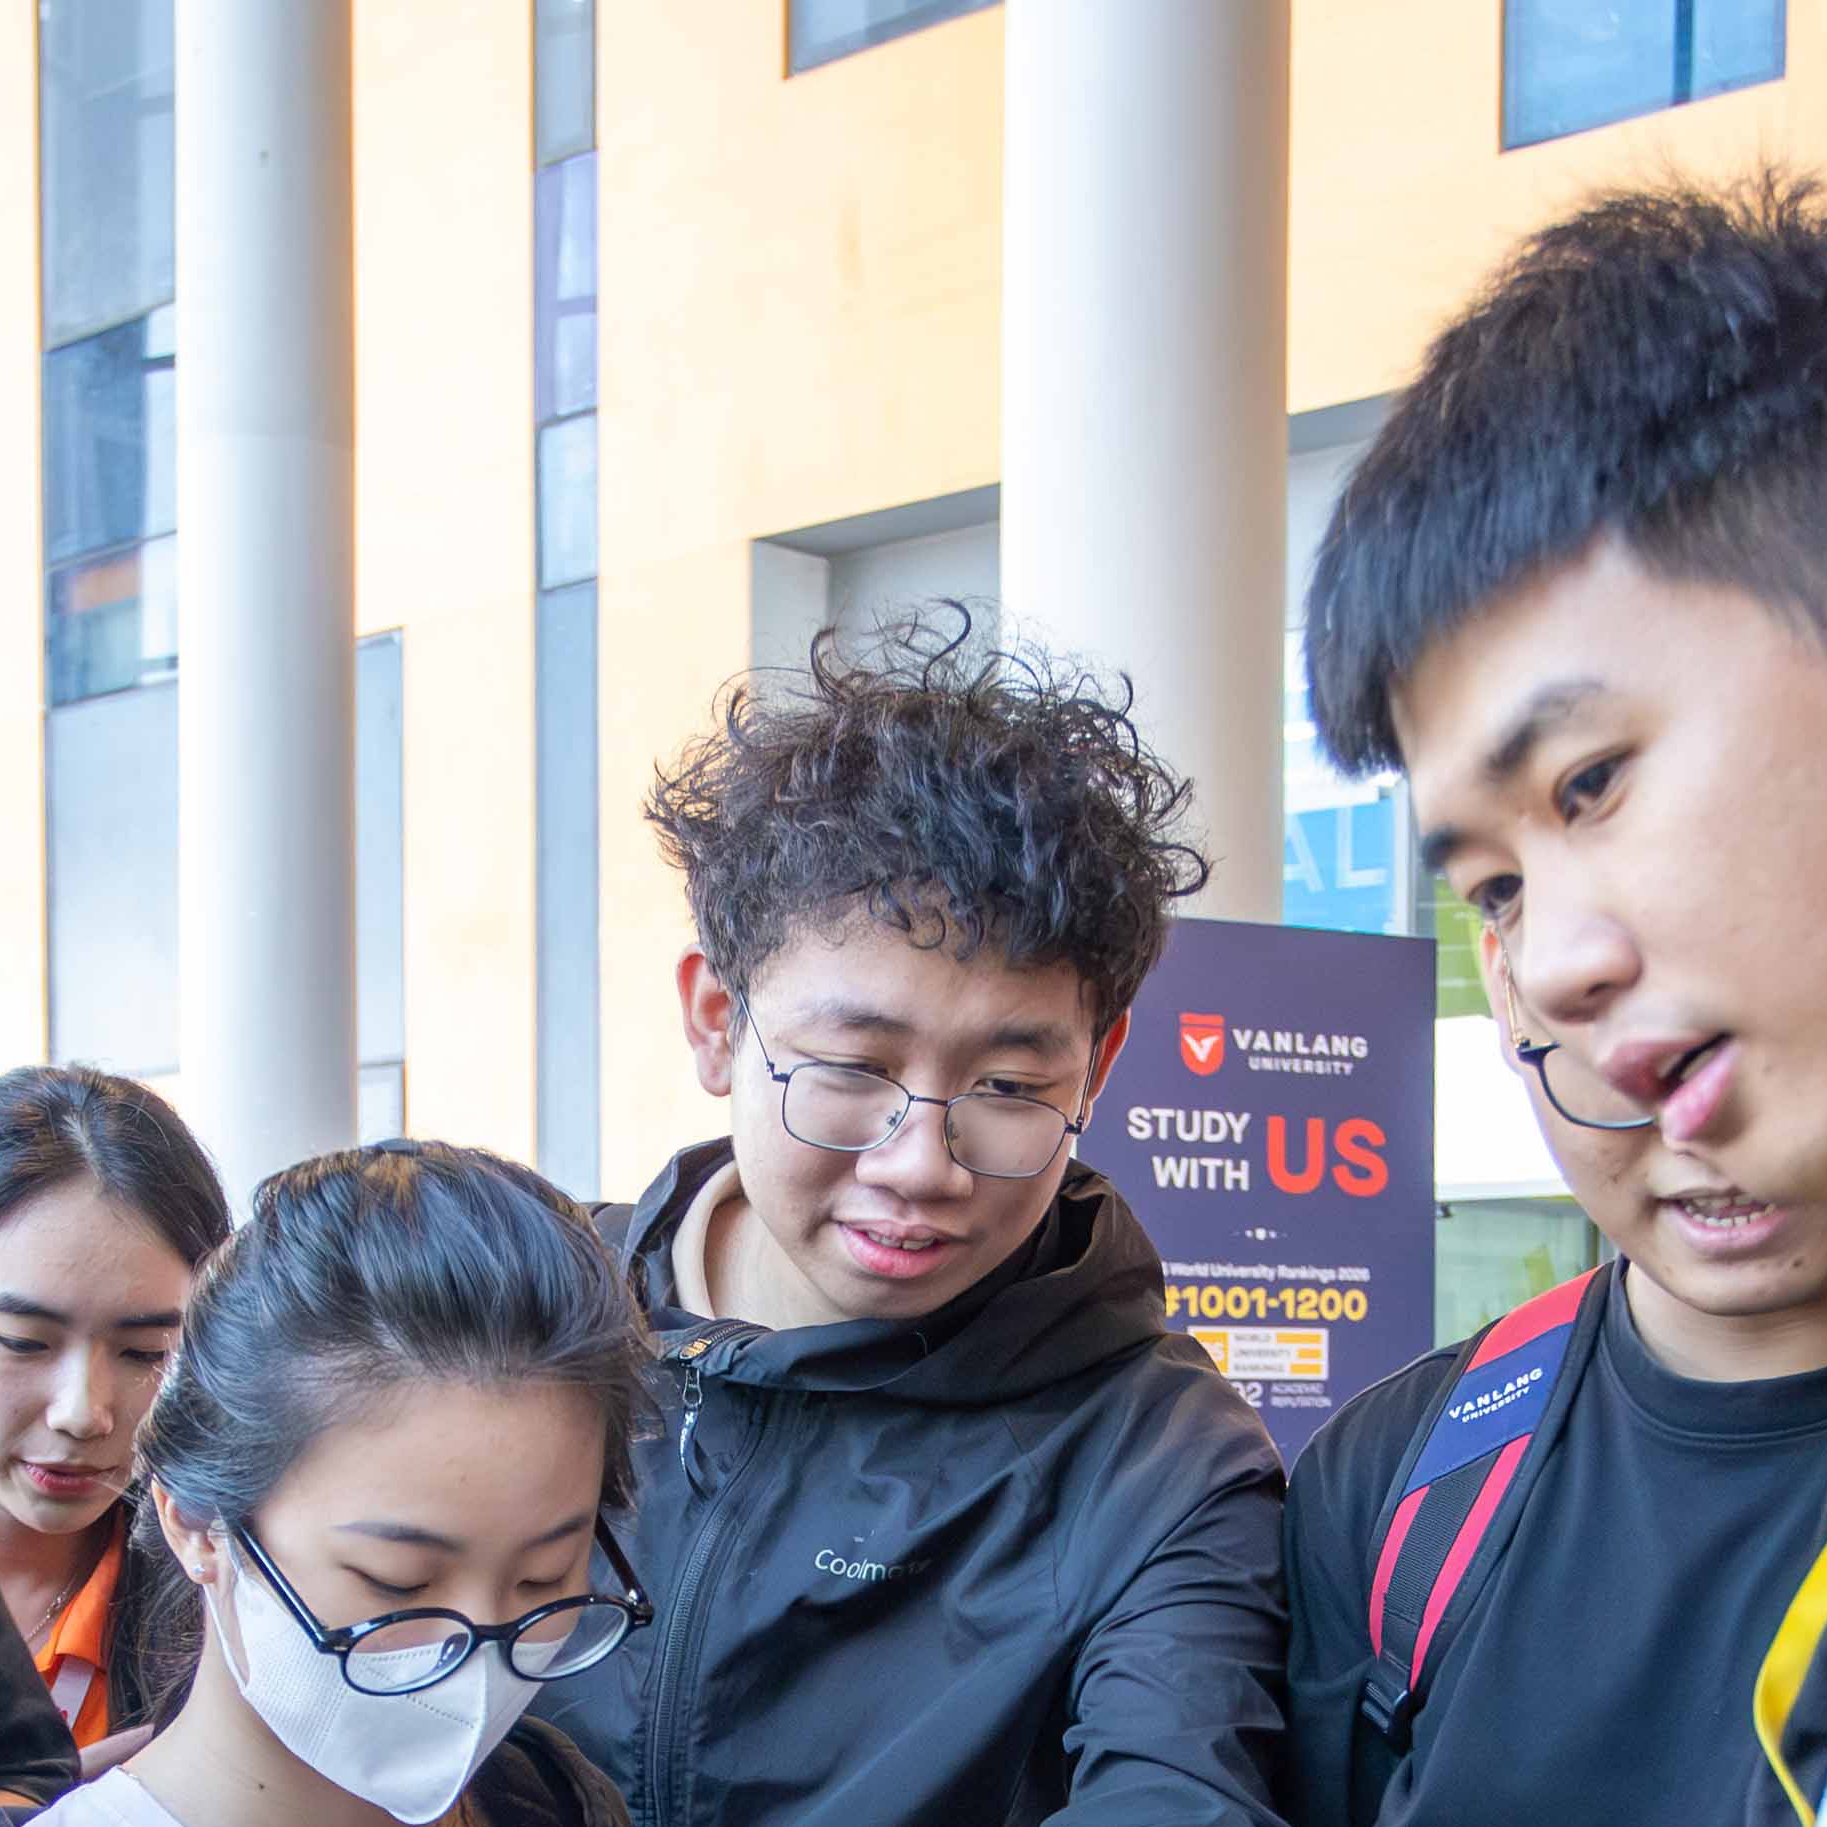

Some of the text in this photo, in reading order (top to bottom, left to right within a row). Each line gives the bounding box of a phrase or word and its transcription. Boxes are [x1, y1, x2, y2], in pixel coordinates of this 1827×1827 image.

[1232, 1028, 1369, 1058] VANLANG
[1248, 1056, 1354, 1076] UNIVERSITY
[1127, 1106, 1252, 1143] STUDY
[1151, 1155, 1251, 1192] WITH
[1266, 1114, 1389, 1197] US
[1210, 1263, 1274, 1281] University
[1277, 1264, 1336, 1283] Rankings
[1164, 1284, 1369, 1322] #1001-1200
[1448, 1367, 1543, 1419] VANLANG
[1461, 1386, 1531, 1423] UNIVERSITY
